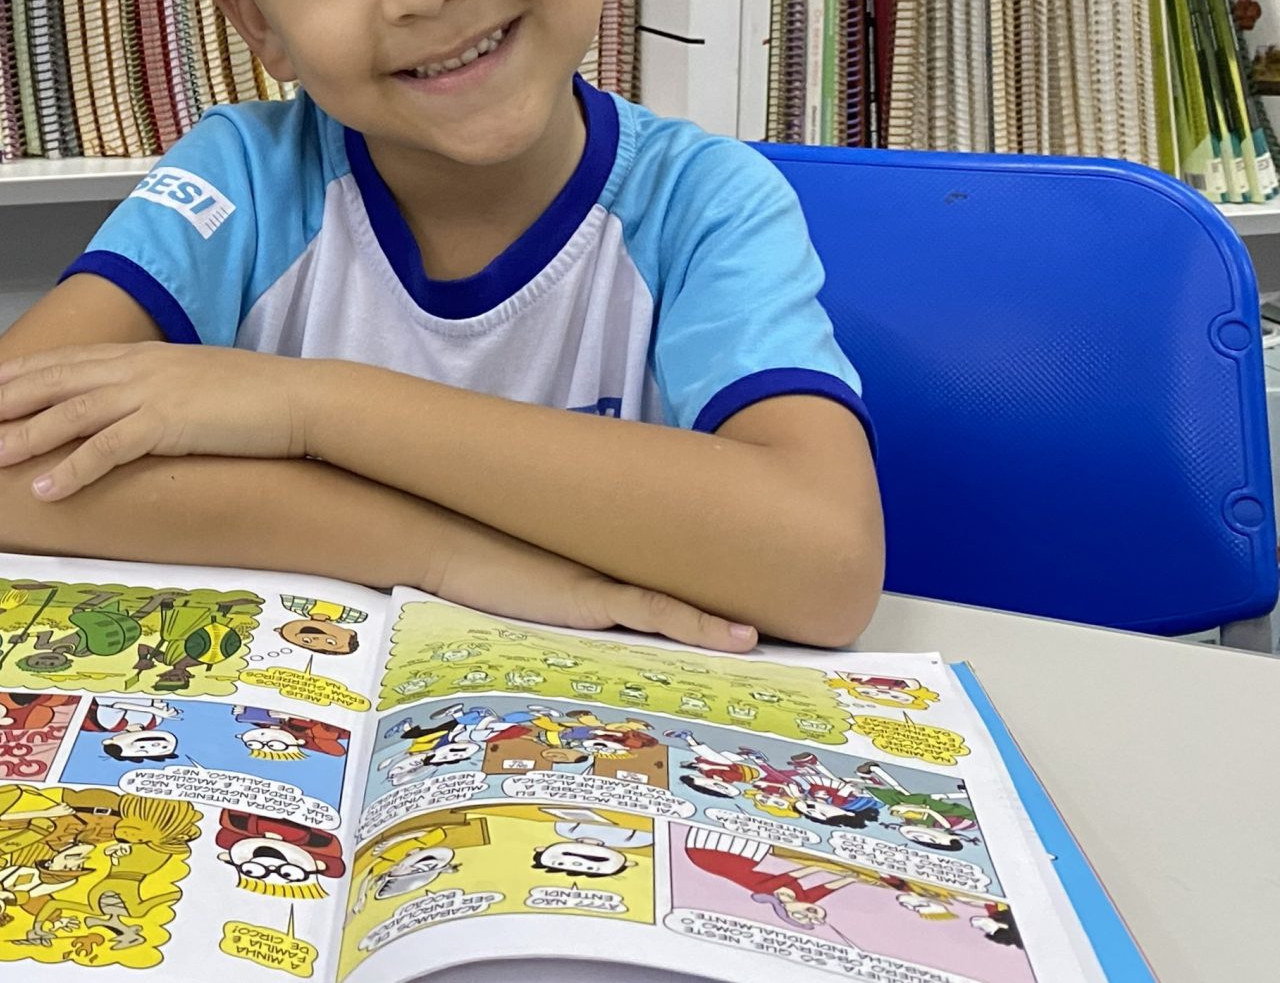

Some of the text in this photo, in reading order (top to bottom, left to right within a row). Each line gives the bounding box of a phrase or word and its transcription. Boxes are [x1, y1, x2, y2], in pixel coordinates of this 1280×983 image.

[135, 173, 216, 215] SESI
[245, 672, 364, 704] ERAM GUERREIROS
[325, 681, 341, 689] NA
[256, 679, 353, 706] ANTEPASSADOS
[286, 690, 321, 702] MEUS
[880, 744, 951, 763] NA MINHA
[135, 771, 216, 786] MAQUIAGEM
[140, 778, 169, 790] NÃO
[434, 773, 476, 785] NESTE
[438, 779, 475, 789] PAPO
[175, 783, 257, 801] ENGRAÇADA
[277, 784, 294, 794] DE
[431, 785, 483, 798] MUNDO
[541, 784, 593, 795] SOBRE
[645, 786, 666, 796] DA
[264, 796, 301, 810] CARA
[427, 793, 466, 805] HOJE
[600, 791, 639, 802] TUDO
[135, 786, 323, 825] AH, AGORA ENTENDI! ESSA
[312, 802, 329, 812] DE
[386, 795, 425, 813] VINDO
[616, 800, 649, 810] SER
[647, 799, 673, 808] SEI
[306, 807, 334, 821] SUA
[655, 808, 681, 817] VAI
[716, 815, 809, 842] ESTOU SEM
[768, 834, 793, 843] SEI
[875, 843, 929, 859] PEDRO
[840, 845, 980, 883] AQUELA DO DOM
[915, 859, 975, 877] PEDRO
[937, 858, 973, 871] DOM
[462, 896, 495, 905] SER
[531, 898, 567, 906] NÃO
[396, 904, 482, 932] ACABAMOS
[681, 917, 694, 925] O
[683, 926, 740, 944] NESTE
[703, 923, 754, 939] COMO
[232, 926, 309, 954] DE CIRCO!
[236, 945, 300, 970] A MINHA
[762, 937, 863, 967] OBSERVAR
[800, 954, 826, 967] SÓ
[857, 951, 950, 983] TRABALHA
